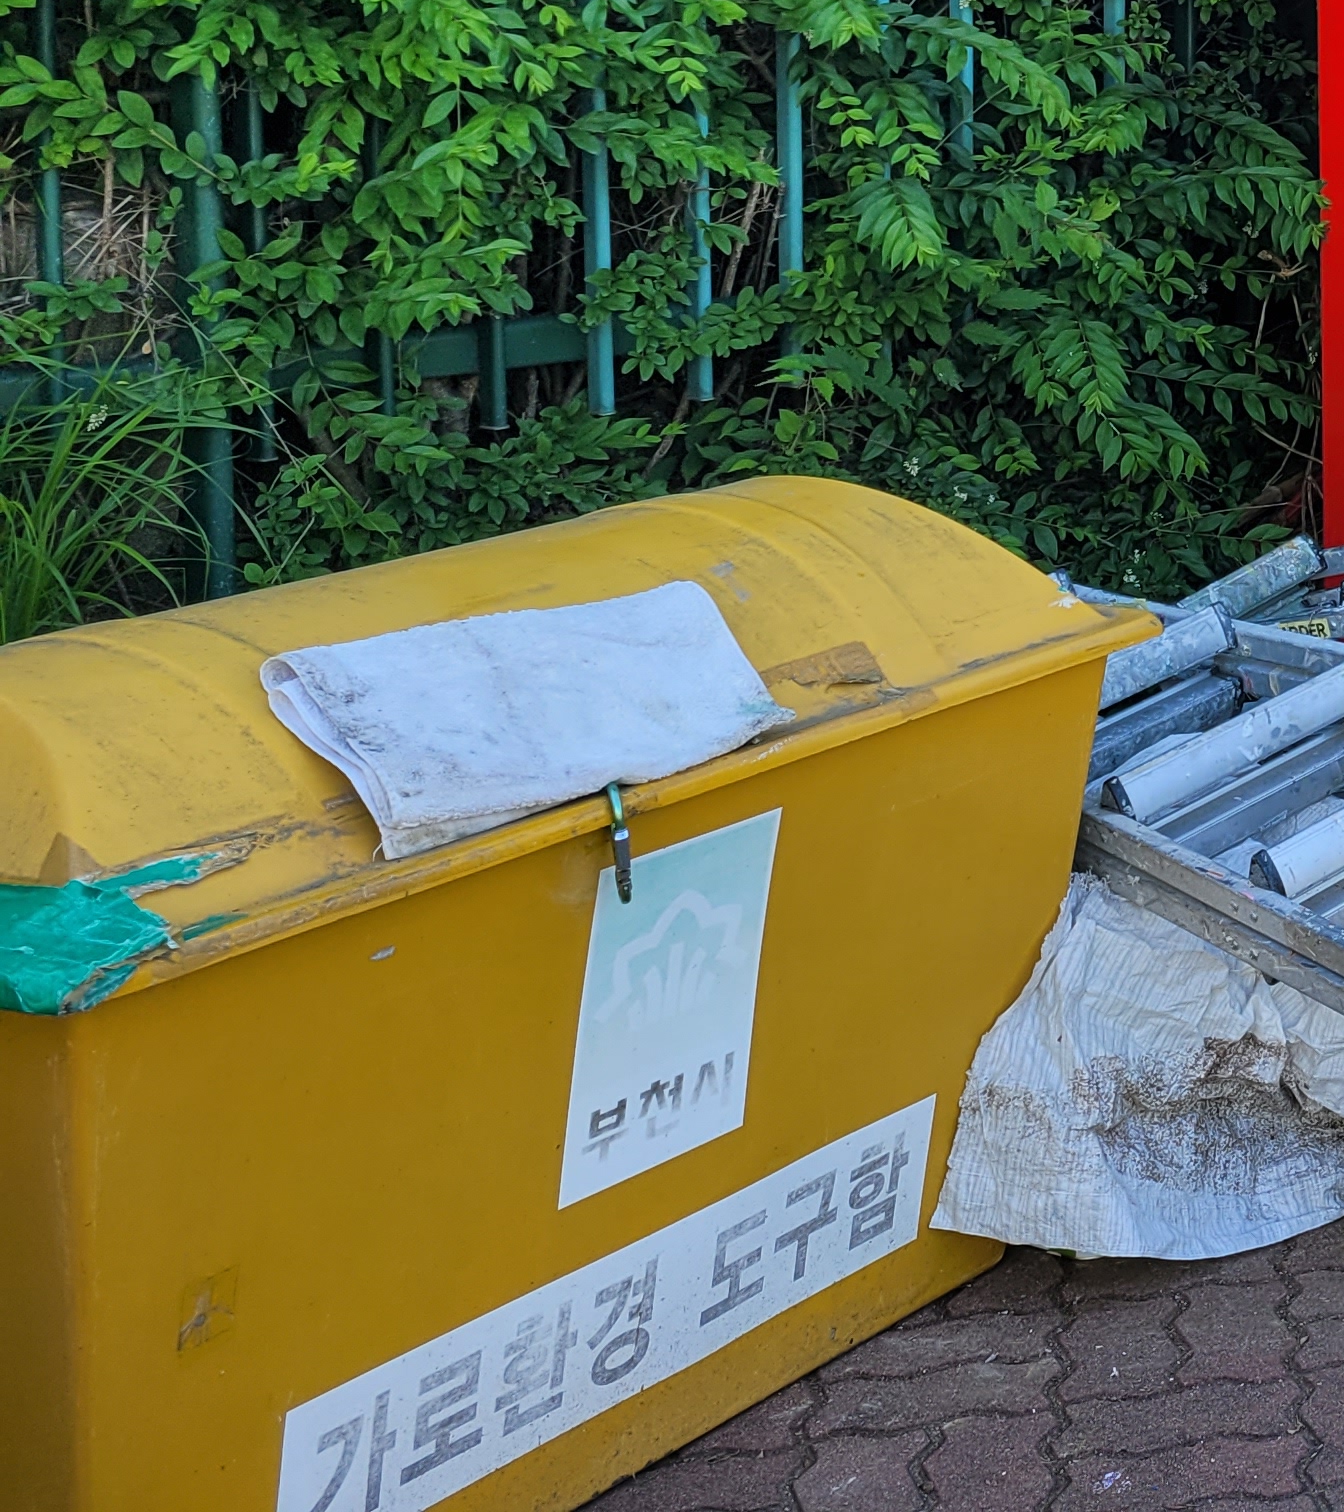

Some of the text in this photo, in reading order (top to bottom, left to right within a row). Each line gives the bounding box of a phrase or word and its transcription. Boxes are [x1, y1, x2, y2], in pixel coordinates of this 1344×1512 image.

[582, 1050, 736, 1162] 부천시
[309, 1131, 911, 1512] 가로환경 도구함
